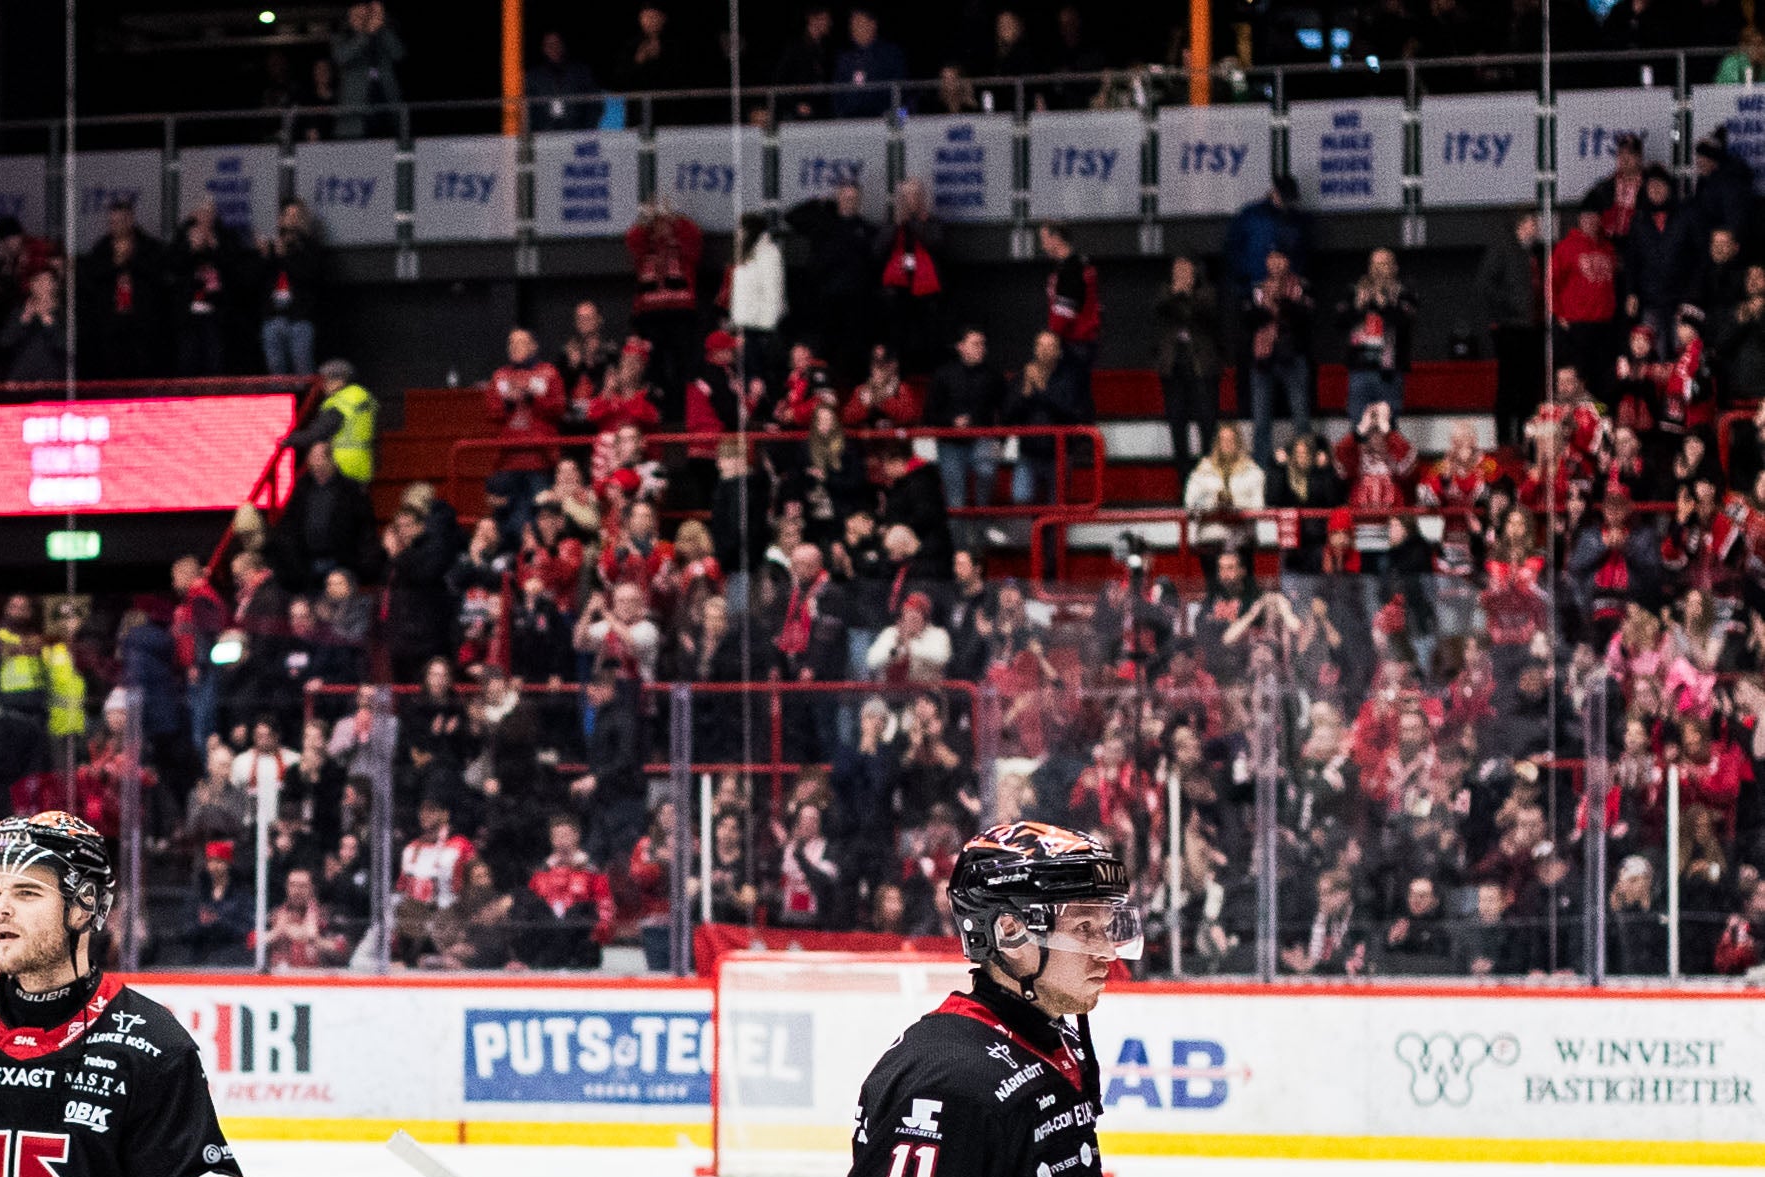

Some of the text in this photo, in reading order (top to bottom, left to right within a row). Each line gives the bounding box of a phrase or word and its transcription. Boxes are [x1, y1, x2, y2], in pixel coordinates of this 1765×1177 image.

[1050, 147, 1117, 181] itsy
[1181, 142, 1248, 175] itsy
[1443, 130, 1513, 166] itsy
[435, 170, 495, 203] itsy
[800, 156, 863, 190] itsy
[315, 176, 376, 208] itsy
[13, 1035, 38, 1047] SHL
[125, 1035, 162, 1057] KÖTT
[64, 1071, 127, 1096] NASTA
[1525, 1076, 1754, 1105] FASTIGHETER
[1074, 1101, 1095, 1127] EXA
